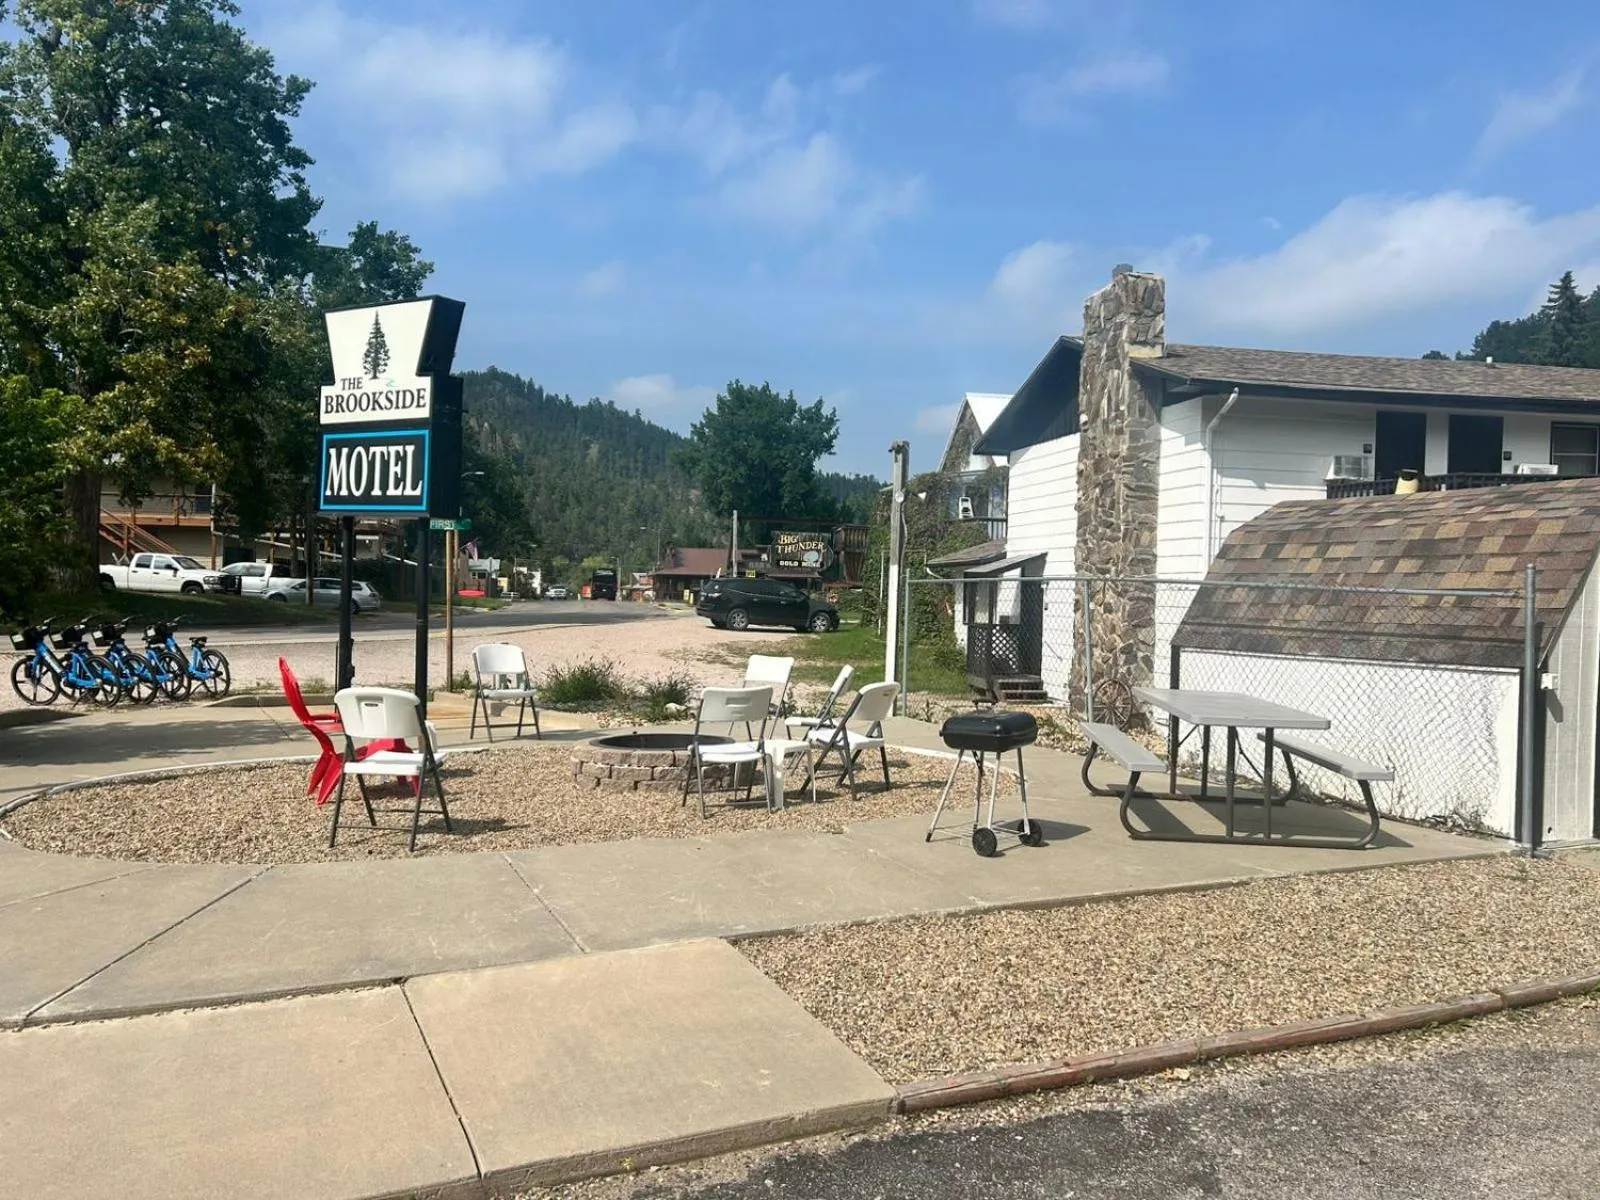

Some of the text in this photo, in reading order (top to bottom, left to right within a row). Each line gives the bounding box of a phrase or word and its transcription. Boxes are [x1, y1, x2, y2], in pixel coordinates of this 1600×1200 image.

[340, 376, 364, 391] THE
[323, 387, 427, 414] BROOKSIDE
[325, 444, 423, 497] MOTEL
[778, 534, 799, 545] BIG
[775, 541, 827, 554] THUNDER
